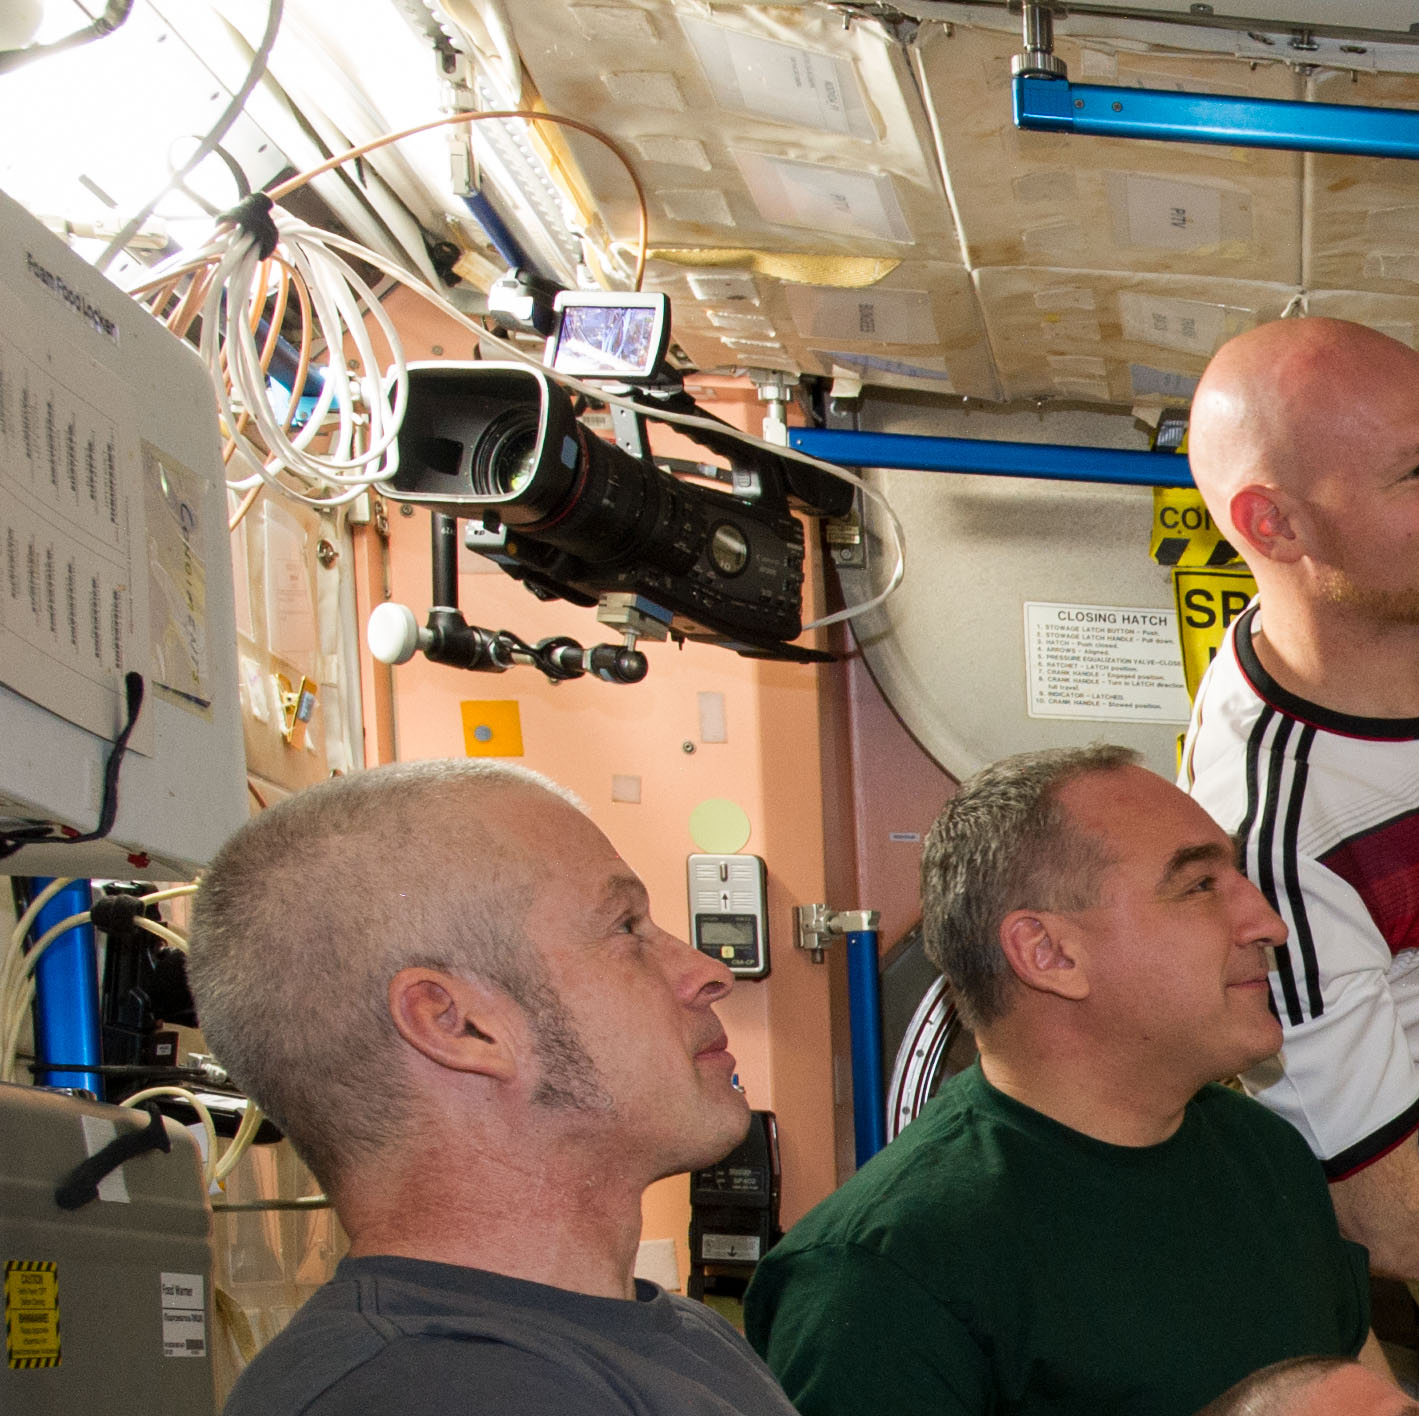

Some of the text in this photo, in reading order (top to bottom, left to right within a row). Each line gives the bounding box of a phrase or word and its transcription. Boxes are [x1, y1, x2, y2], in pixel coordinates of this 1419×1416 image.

[1057, 610, 1168, 626] CLOSING HATCH
[1045, 624, 1079, 632] STOWAGE
[1081, 626, 1105, 634] LATCH
[1107, 627, 1134, 635] BUTTON
[1045, 632, 1080, 640] STOWAGE
[1107, 635, 1134, 643] HANDLE
[1046, 639, 1069, 647] HATCH
[1046, 646, 1076, 654] ARROWS
[1046, 654, 1081, 662] PRESSURE
[1082, 656, 1132, 665] EQUALIZATION
[1047, 662, 1078, 670] RATCHET
[1047, 669, 1070, 677] CRANK
[1072, 670, 1099, 678] HANDLE
[1072, 678, 1100, 686] HANDLE
[1048, 691, 1084, 699] INDICATOR
